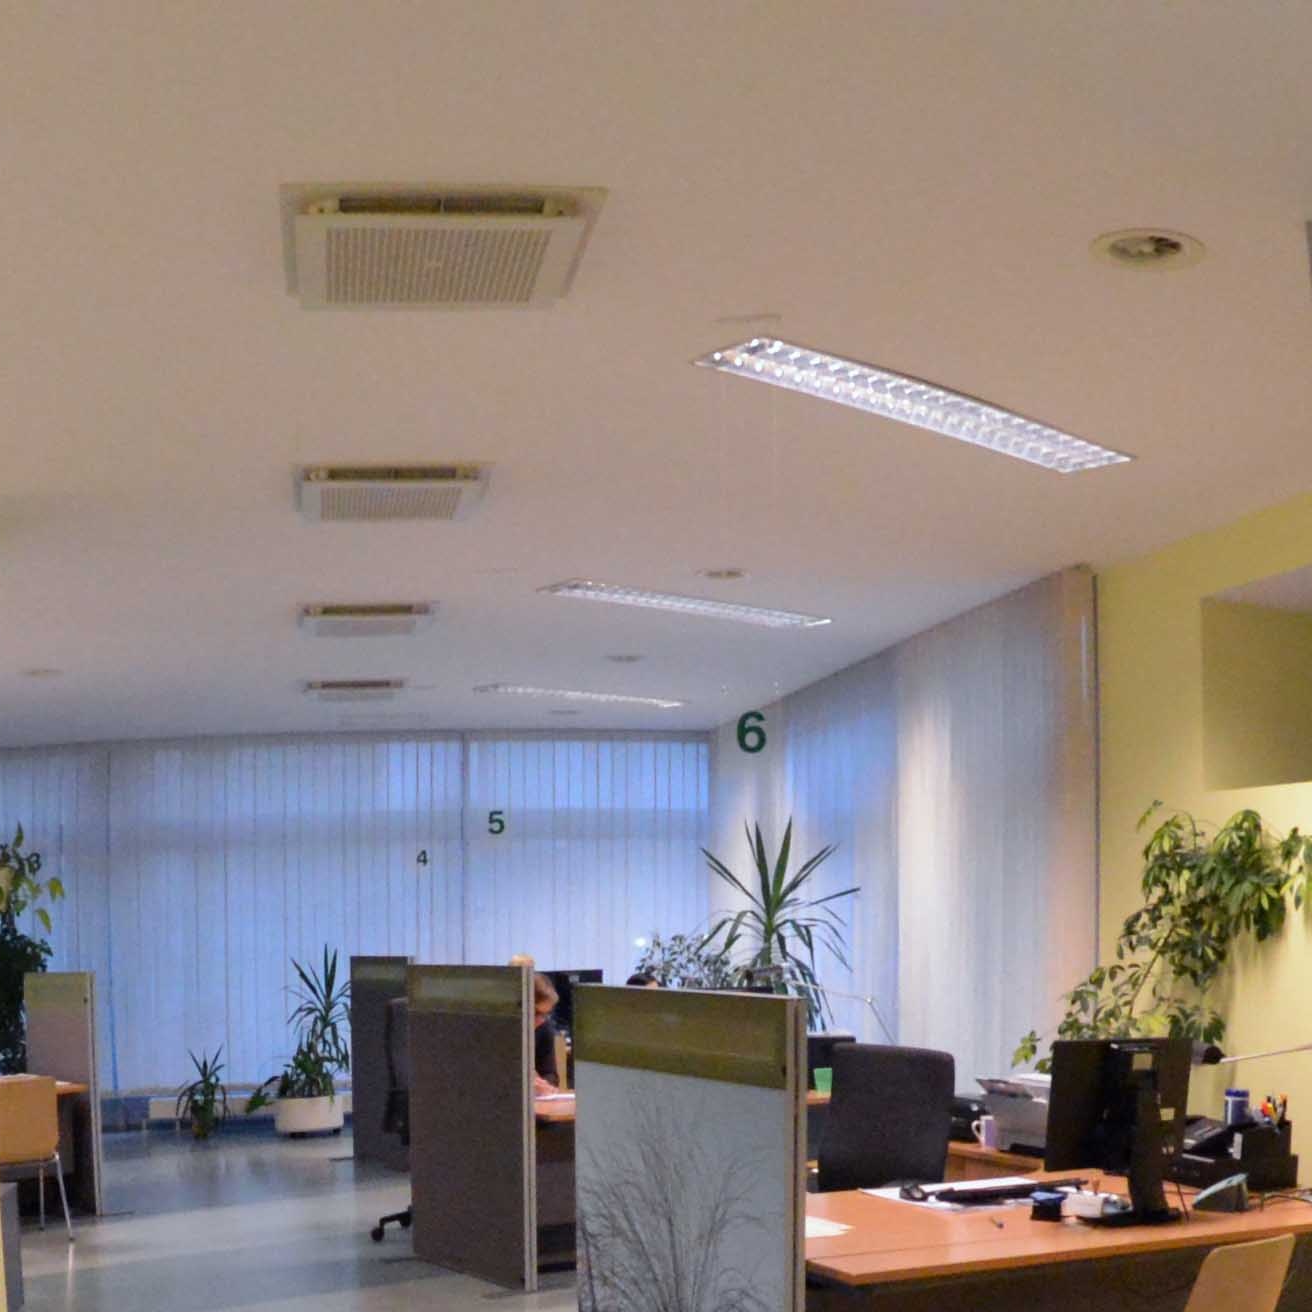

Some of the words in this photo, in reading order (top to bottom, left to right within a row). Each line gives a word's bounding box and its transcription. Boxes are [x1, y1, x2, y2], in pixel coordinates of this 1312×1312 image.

[737, 711, 767, 753] 6
[488, 810, 505, 835] 5
[416, 850, 428, 866] 4
